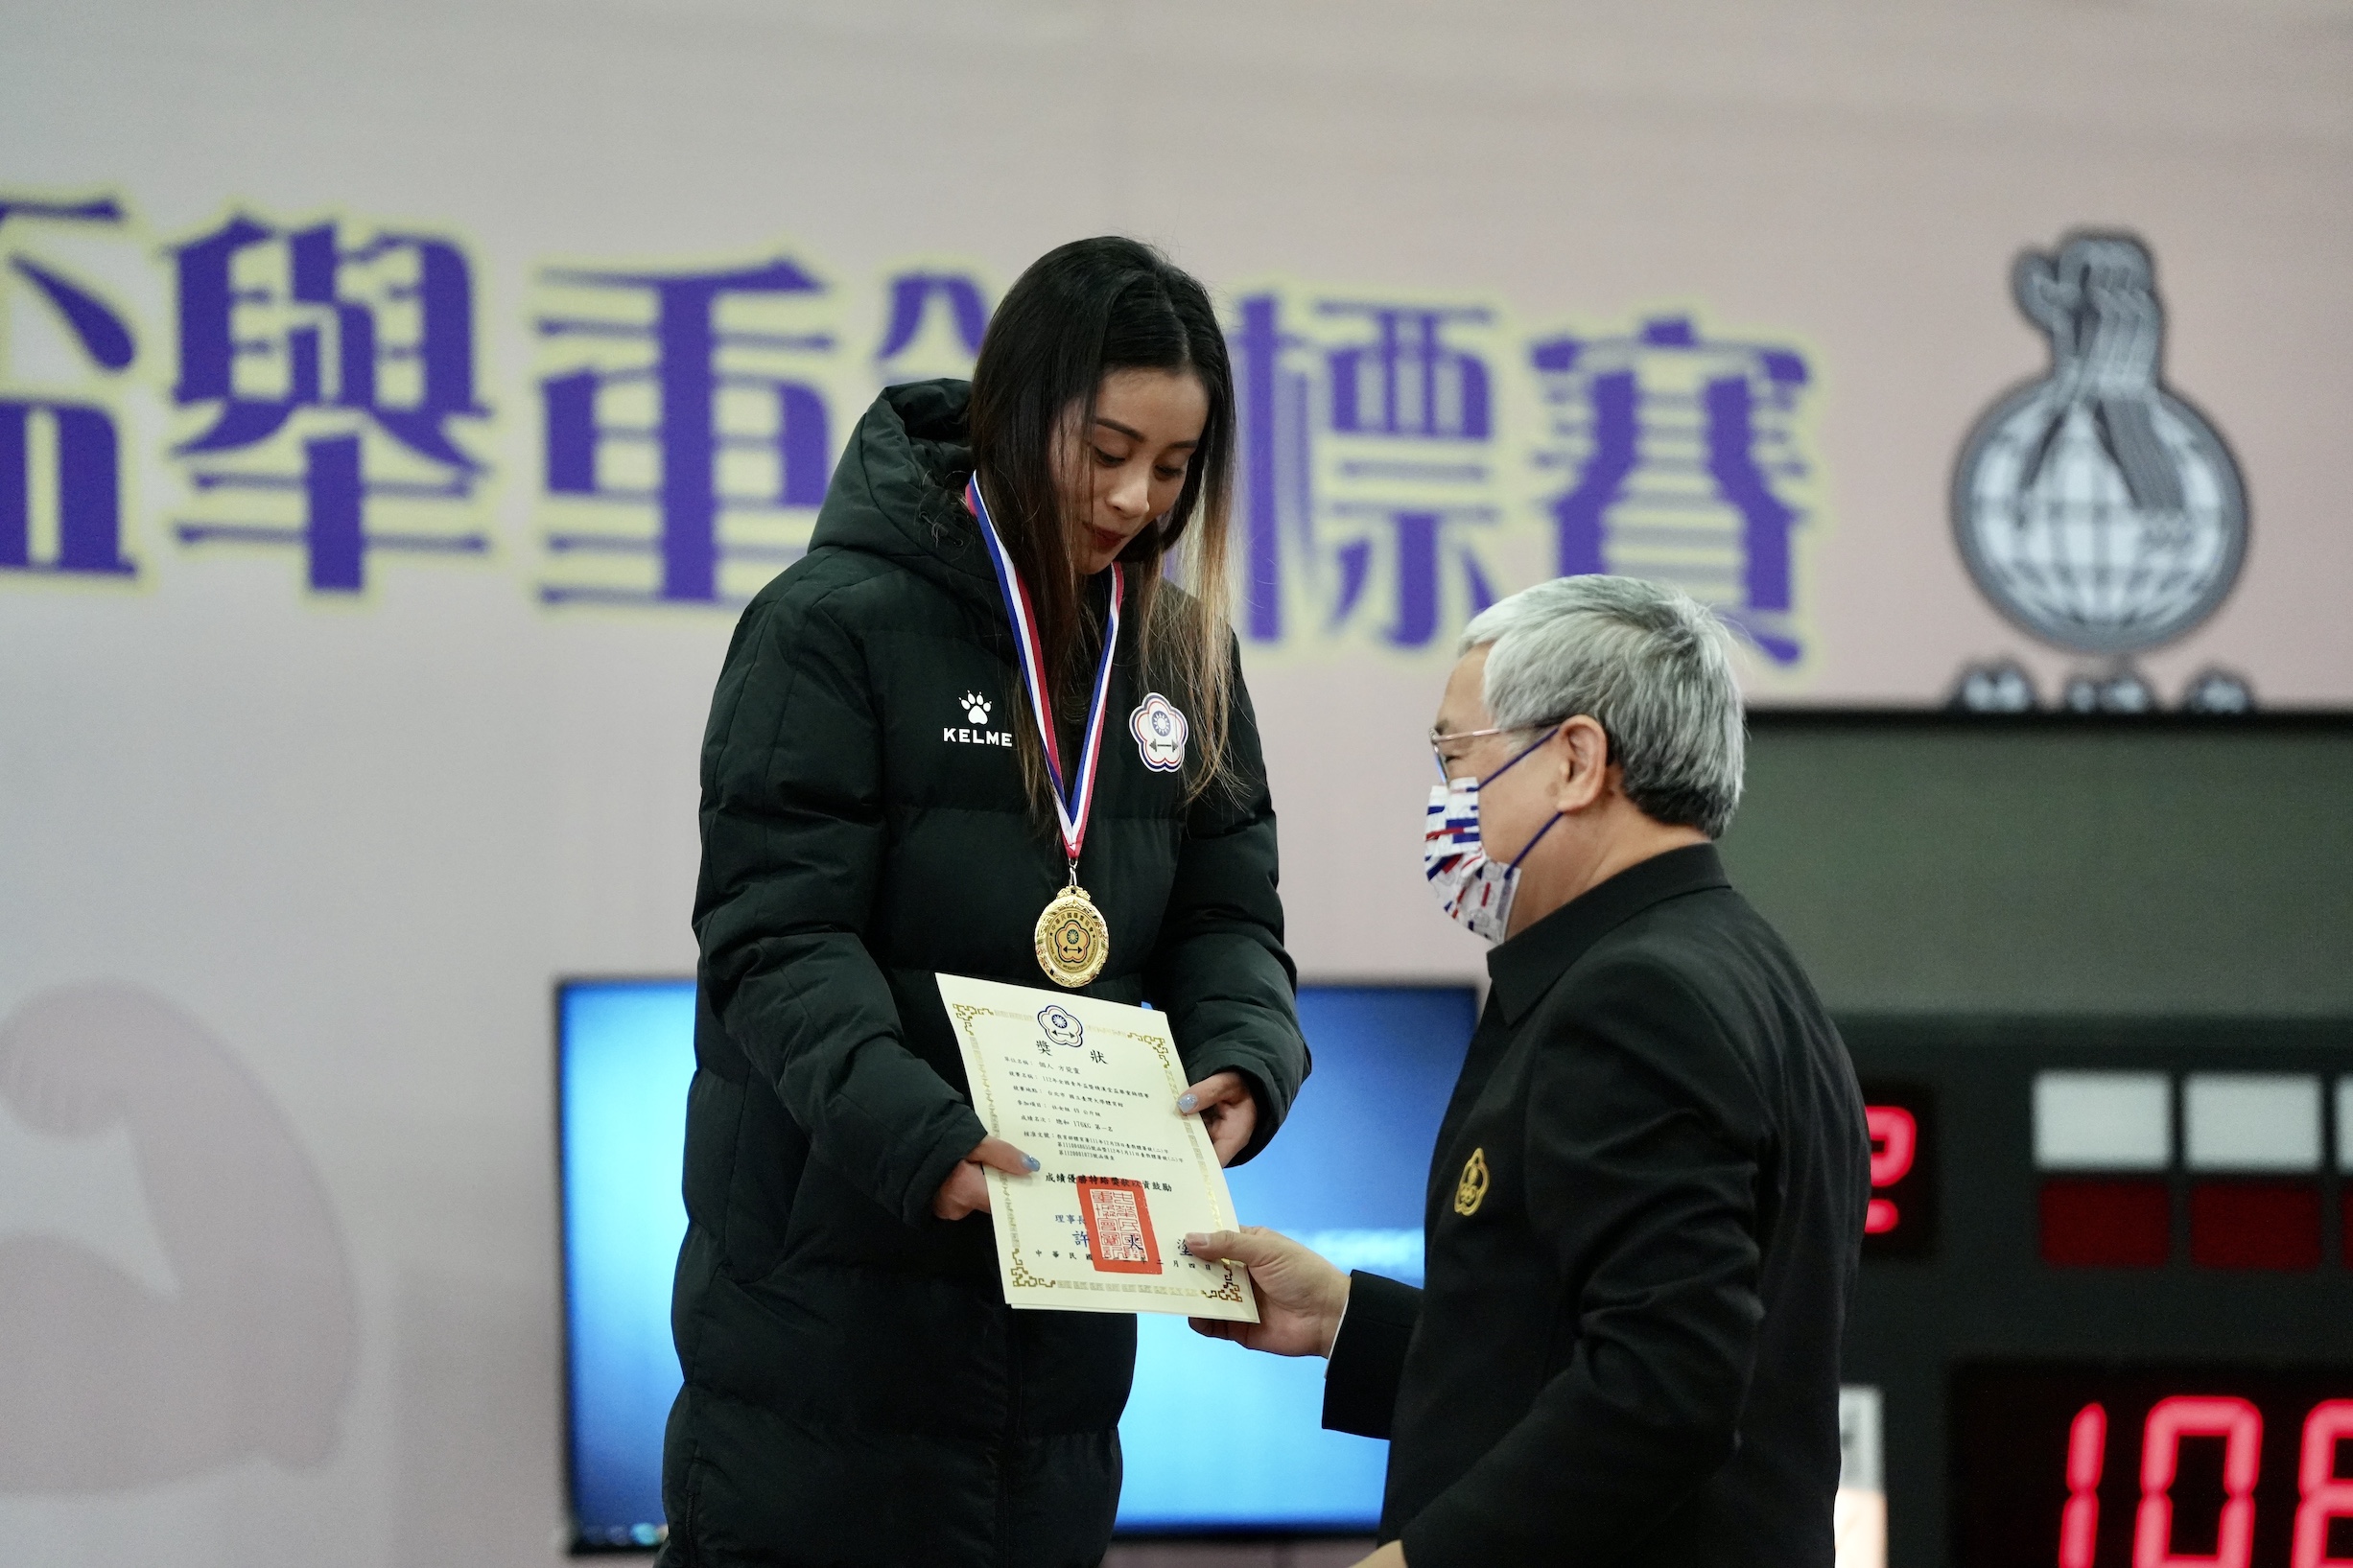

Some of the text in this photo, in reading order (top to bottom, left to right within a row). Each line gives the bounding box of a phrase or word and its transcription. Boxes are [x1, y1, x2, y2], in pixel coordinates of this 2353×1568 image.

[942, 727, 1013, 748] KELME
[1054, 1214, 1086, 1225] 理事長
